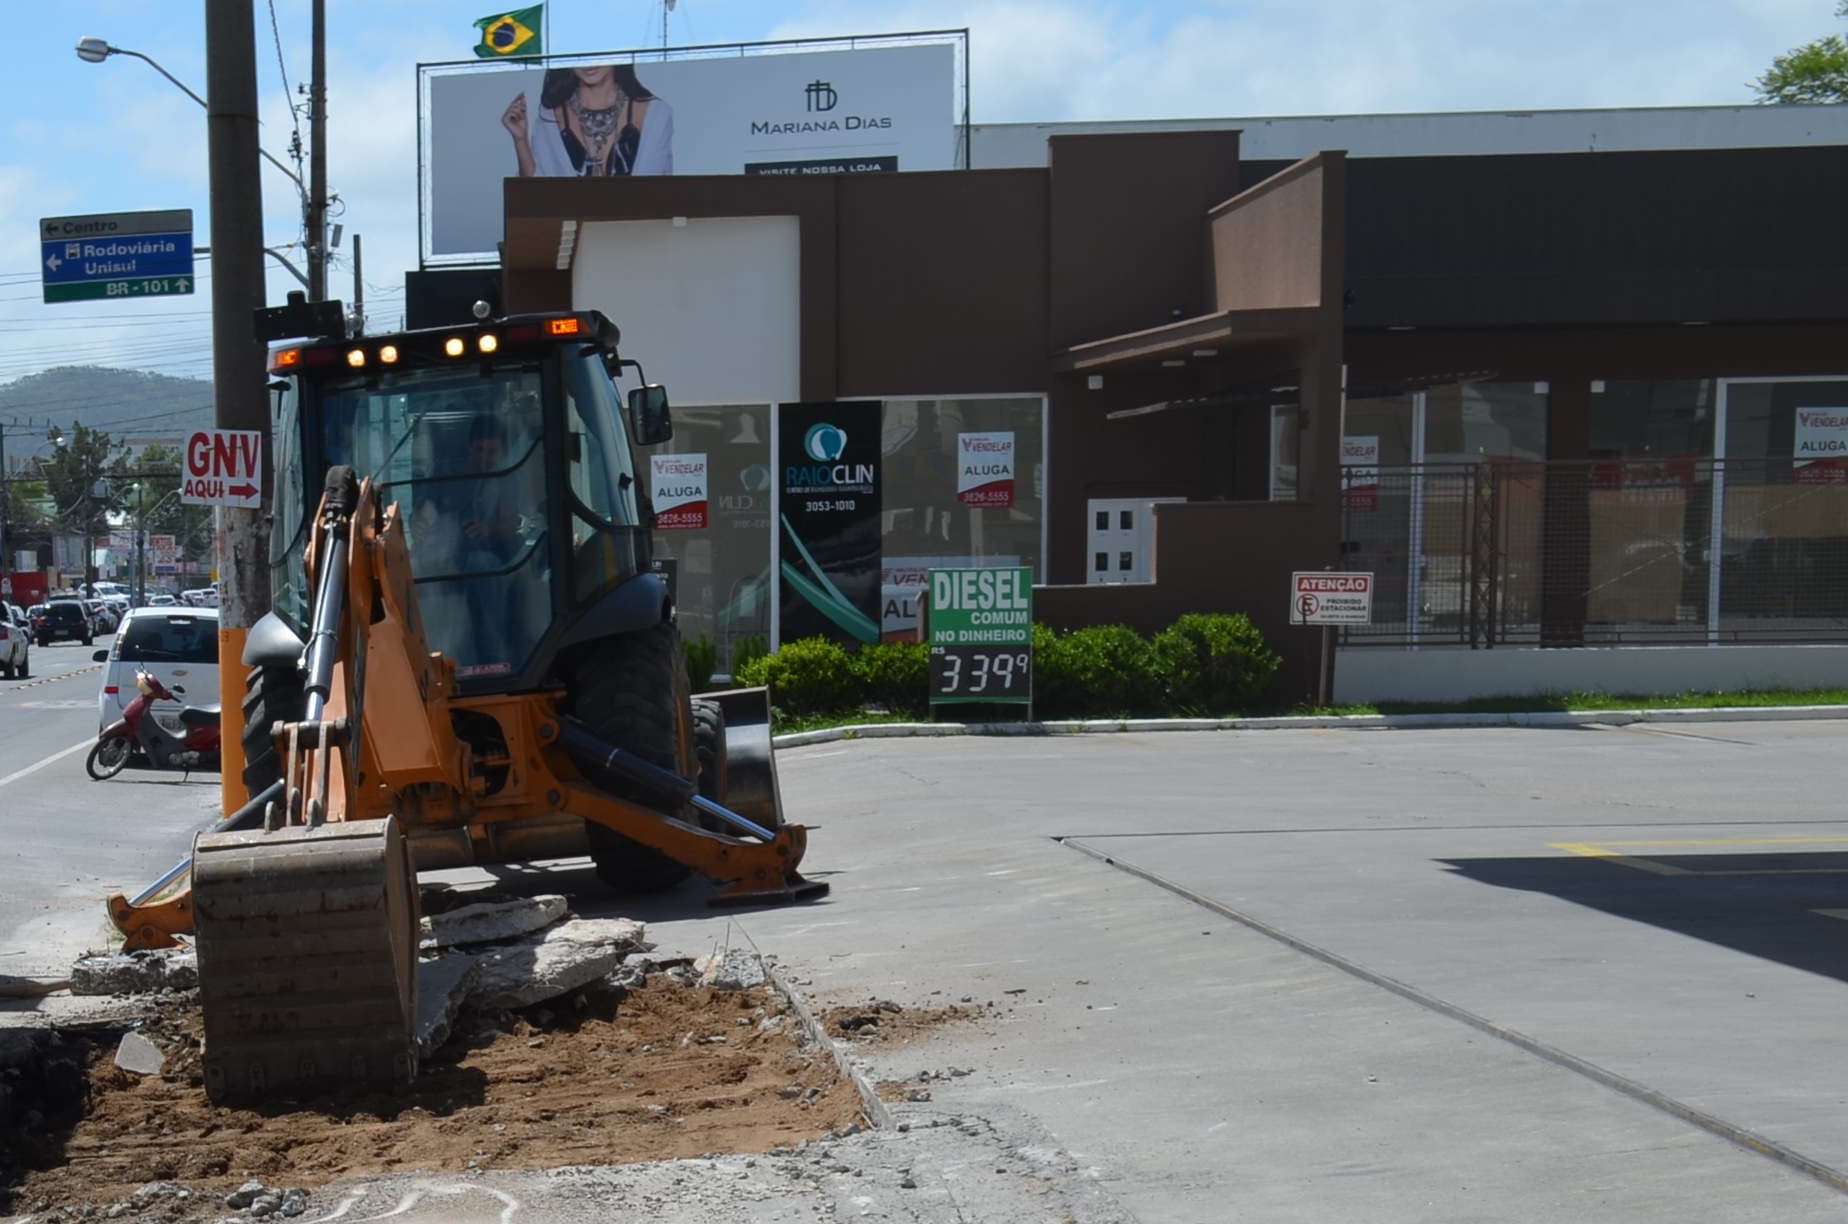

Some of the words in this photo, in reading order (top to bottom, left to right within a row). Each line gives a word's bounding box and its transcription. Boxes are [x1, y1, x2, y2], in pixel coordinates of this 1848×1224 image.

[751, 120, 840, 136] MARIANA
[845, 115, 892, 130] DIAS
[801, 164, 844, 174] NOSSA
[850, 162, 881, 172] LOJA
[63, 221, 118, 235] Centro
[84, 240, 176, 257] Rodoviária
[85, 260, 136, 275] Unisul
[1800, 441, 1847, 452] ALUGA
[188, 432, 259, 478] GNV
[786, 464, 874, 485] RAIOCLIN
[965, 464, 1010, 475] ALUGA
[184, 480, 223, 498] AQUI
[658, 486, 703, 498] ALUGA
[806, 500, 856, 511] 3053-1010
[934, 571, 1028, 610] DIESEL
[1300, 577, 1366, 592] ATENÇÃO
[971, 611, 1028, 625] COMUM
[935, 630, 955, 642] NO
[960, 629, 1026, 642] DINHEIRO
